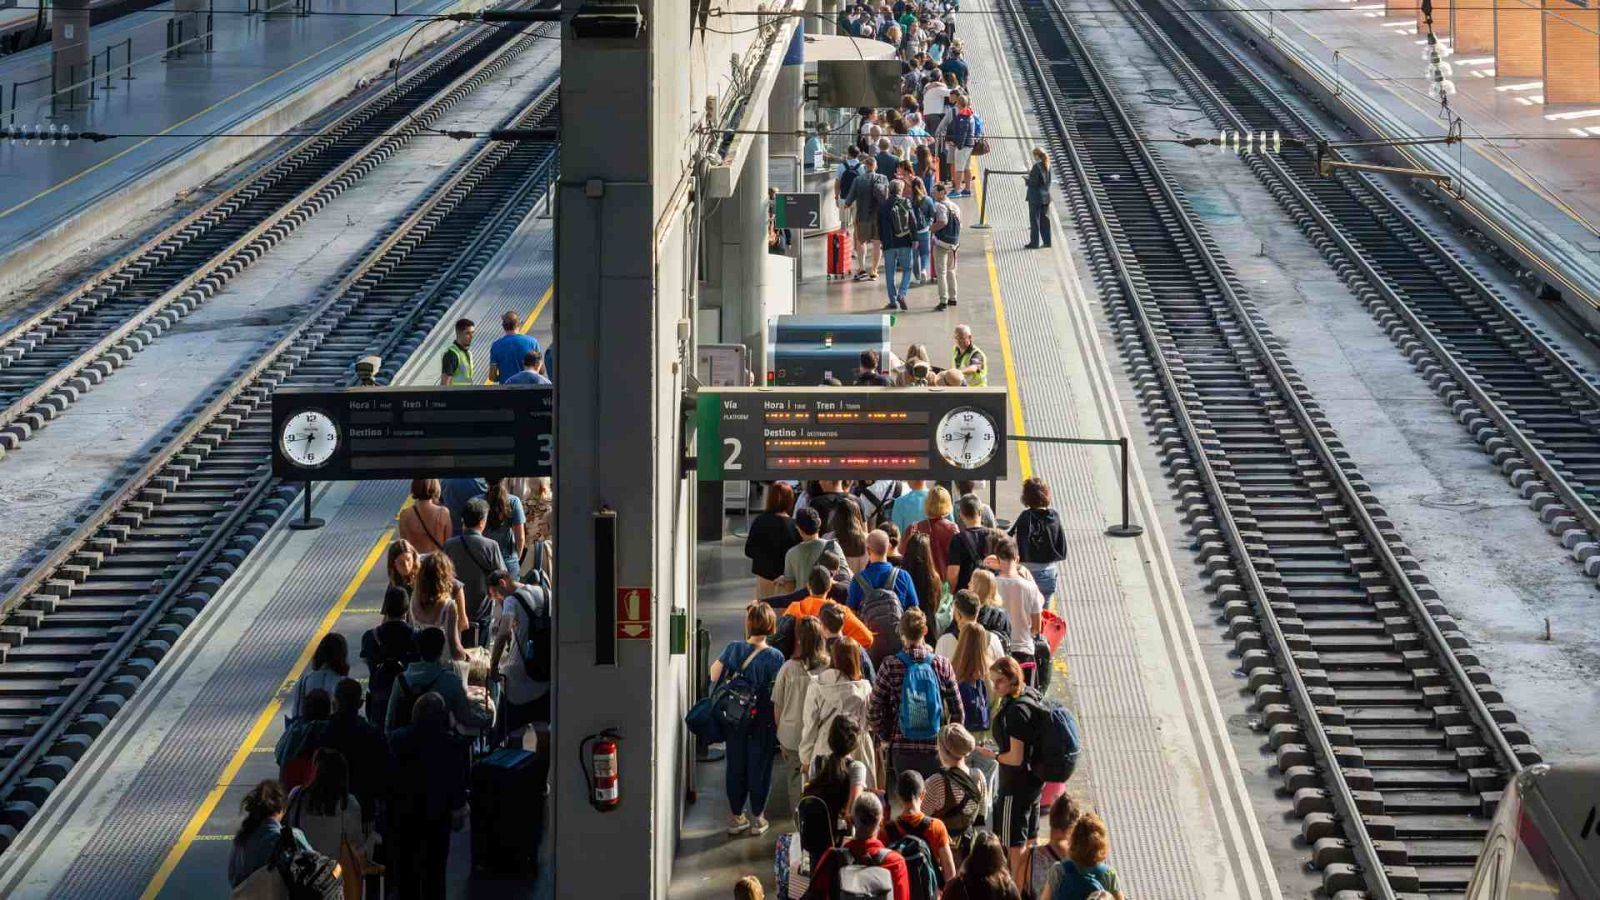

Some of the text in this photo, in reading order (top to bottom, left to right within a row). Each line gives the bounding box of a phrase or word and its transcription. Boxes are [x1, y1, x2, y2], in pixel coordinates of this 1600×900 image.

[808, 211, 818, 227] 2
[349, 400, 370, 409] Hora
[402, 400, 421, 408] Tren
[723, 400, 738, 409] Vía
[763, 400, 785, 410] Hora
[816, 401, 836, 410] Tren
[306, 414, 317, 423] 12
[963, 414, 974, 422] 12
[327, 433, 334, 441] 3
[349, 428, 383, 437] Destino
[763, 428, 797, 438] Destino
[983, 433, 991, 441] 3
[288, 434, 296, 442] 9
[945, 433, 953, 442] 9
[537, 433, 553, 466] 3
[723, 437, 742, 470] 2
[307, 453, 315, 461] 6
[964, 452, 971, 460] 6
